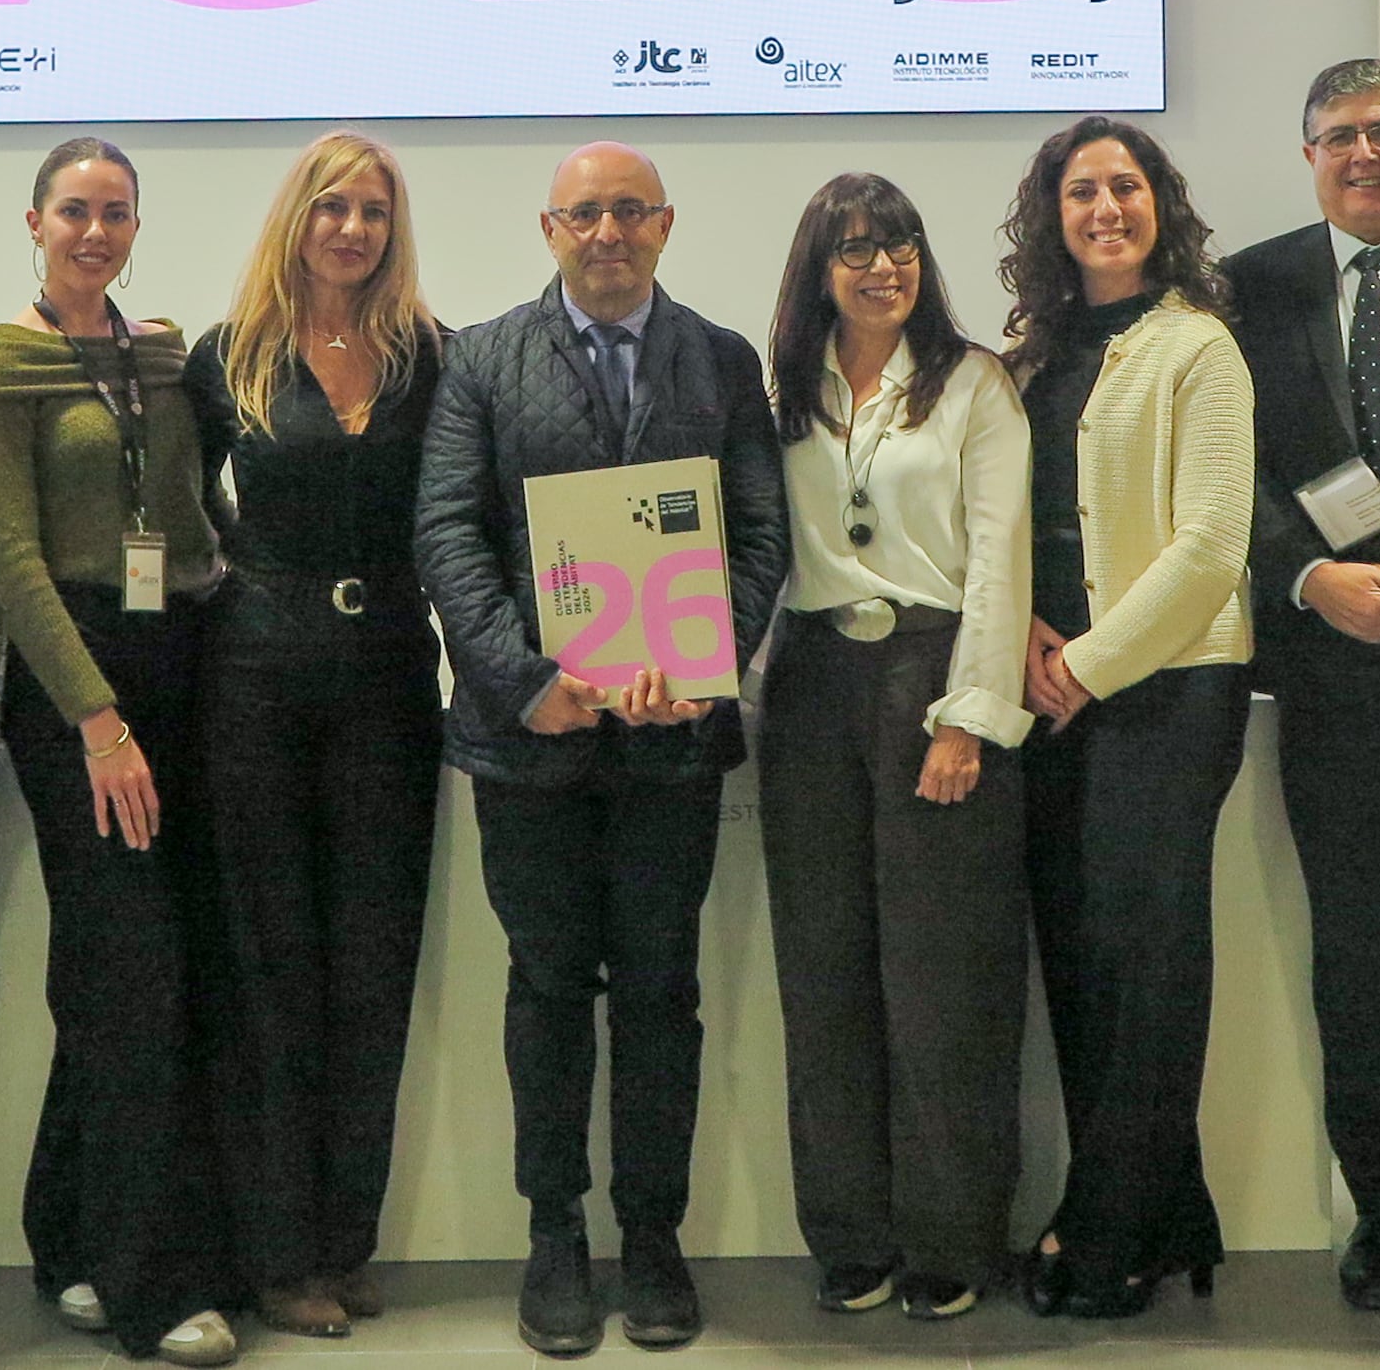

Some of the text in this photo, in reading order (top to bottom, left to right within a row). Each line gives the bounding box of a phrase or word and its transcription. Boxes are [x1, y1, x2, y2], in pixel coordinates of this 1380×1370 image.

[893, 52, 989, 66] AIDIMME
[1030, 53, 1099, 67] REDIT
[892, 67, 933, 76] INSTITUTO
[1030, 70, 1130, 80] INNOVATION NETWORK
[550, 563, 563, 617] CUADERNO
[538, 547, 737, 688] 26
